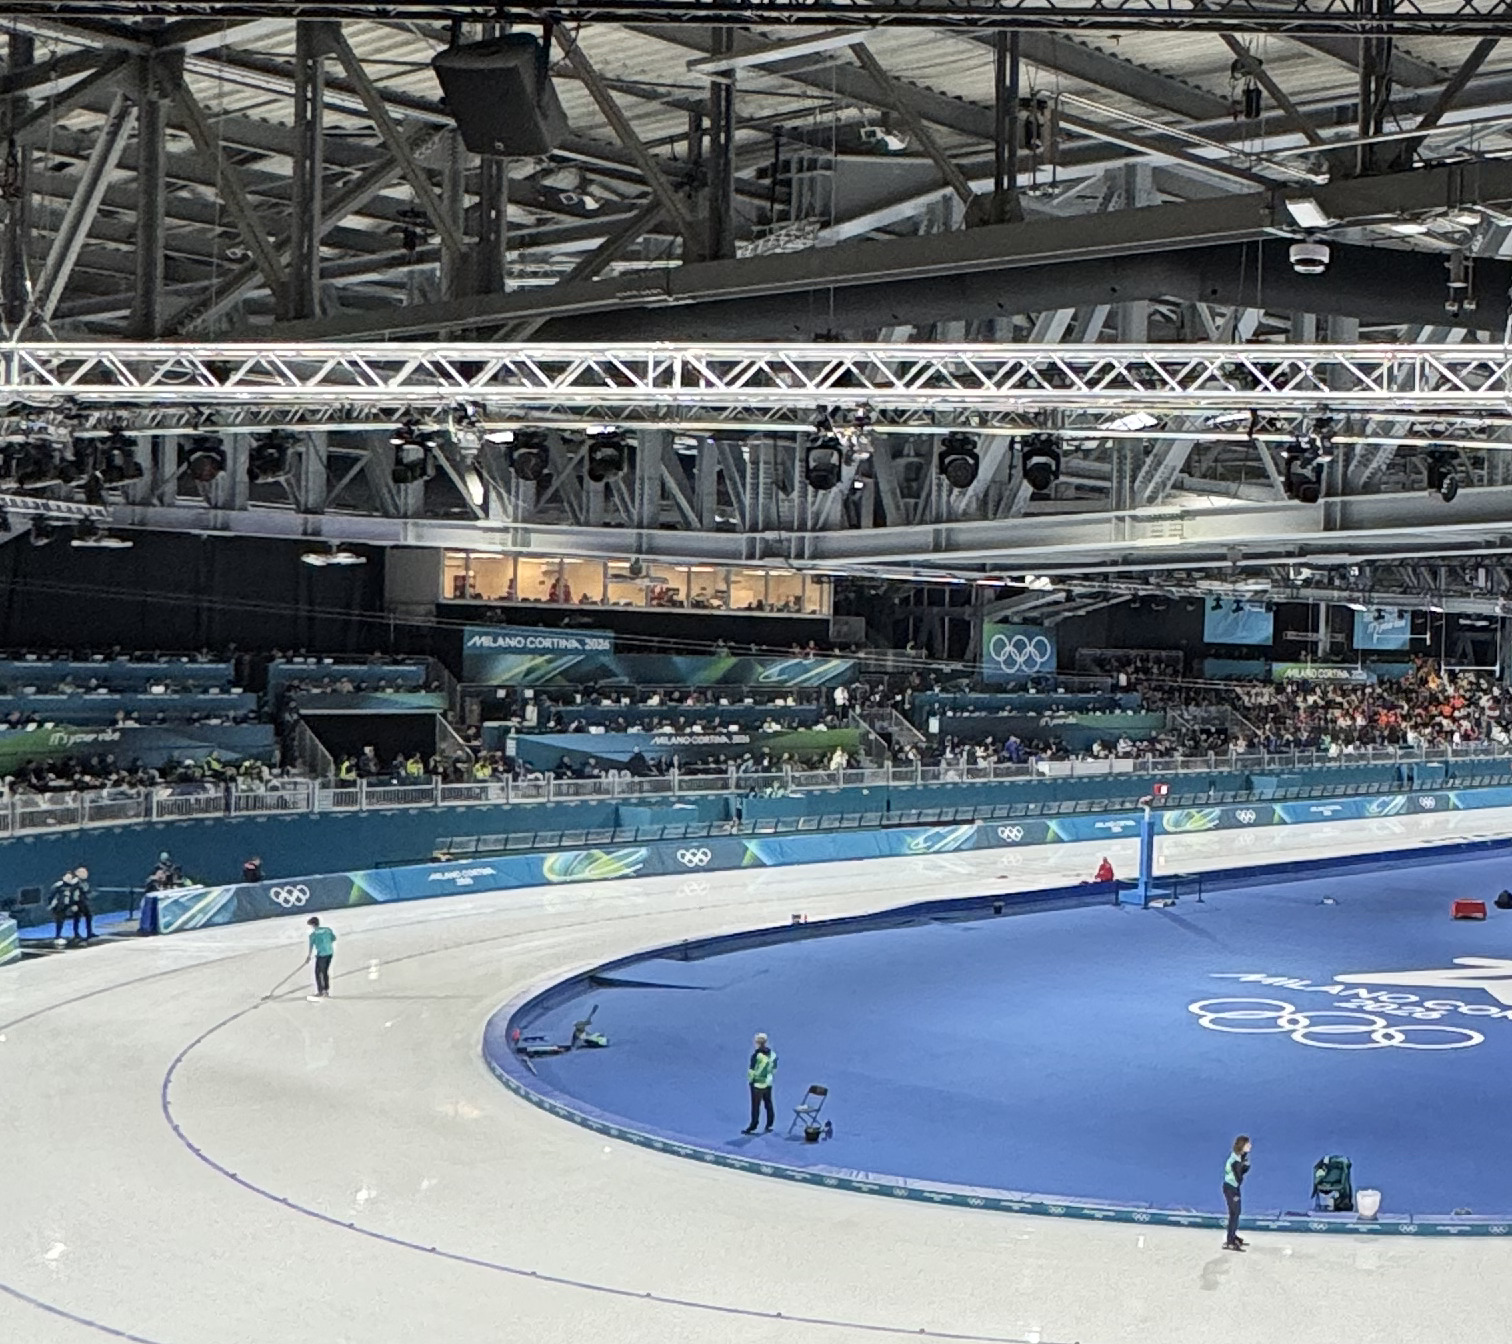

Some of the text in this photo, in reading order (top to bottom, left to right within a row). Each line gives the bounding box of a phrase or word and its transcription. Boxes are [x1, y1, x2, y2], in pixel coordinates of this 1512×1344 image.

[467, 636, 611, 650] MILANO CORTINA 2026
[651, 735, 691, 745] MILANO
[1208, 973, 1420, 1003] MILANO
[1332, 998, 1449, 1020] 2026
